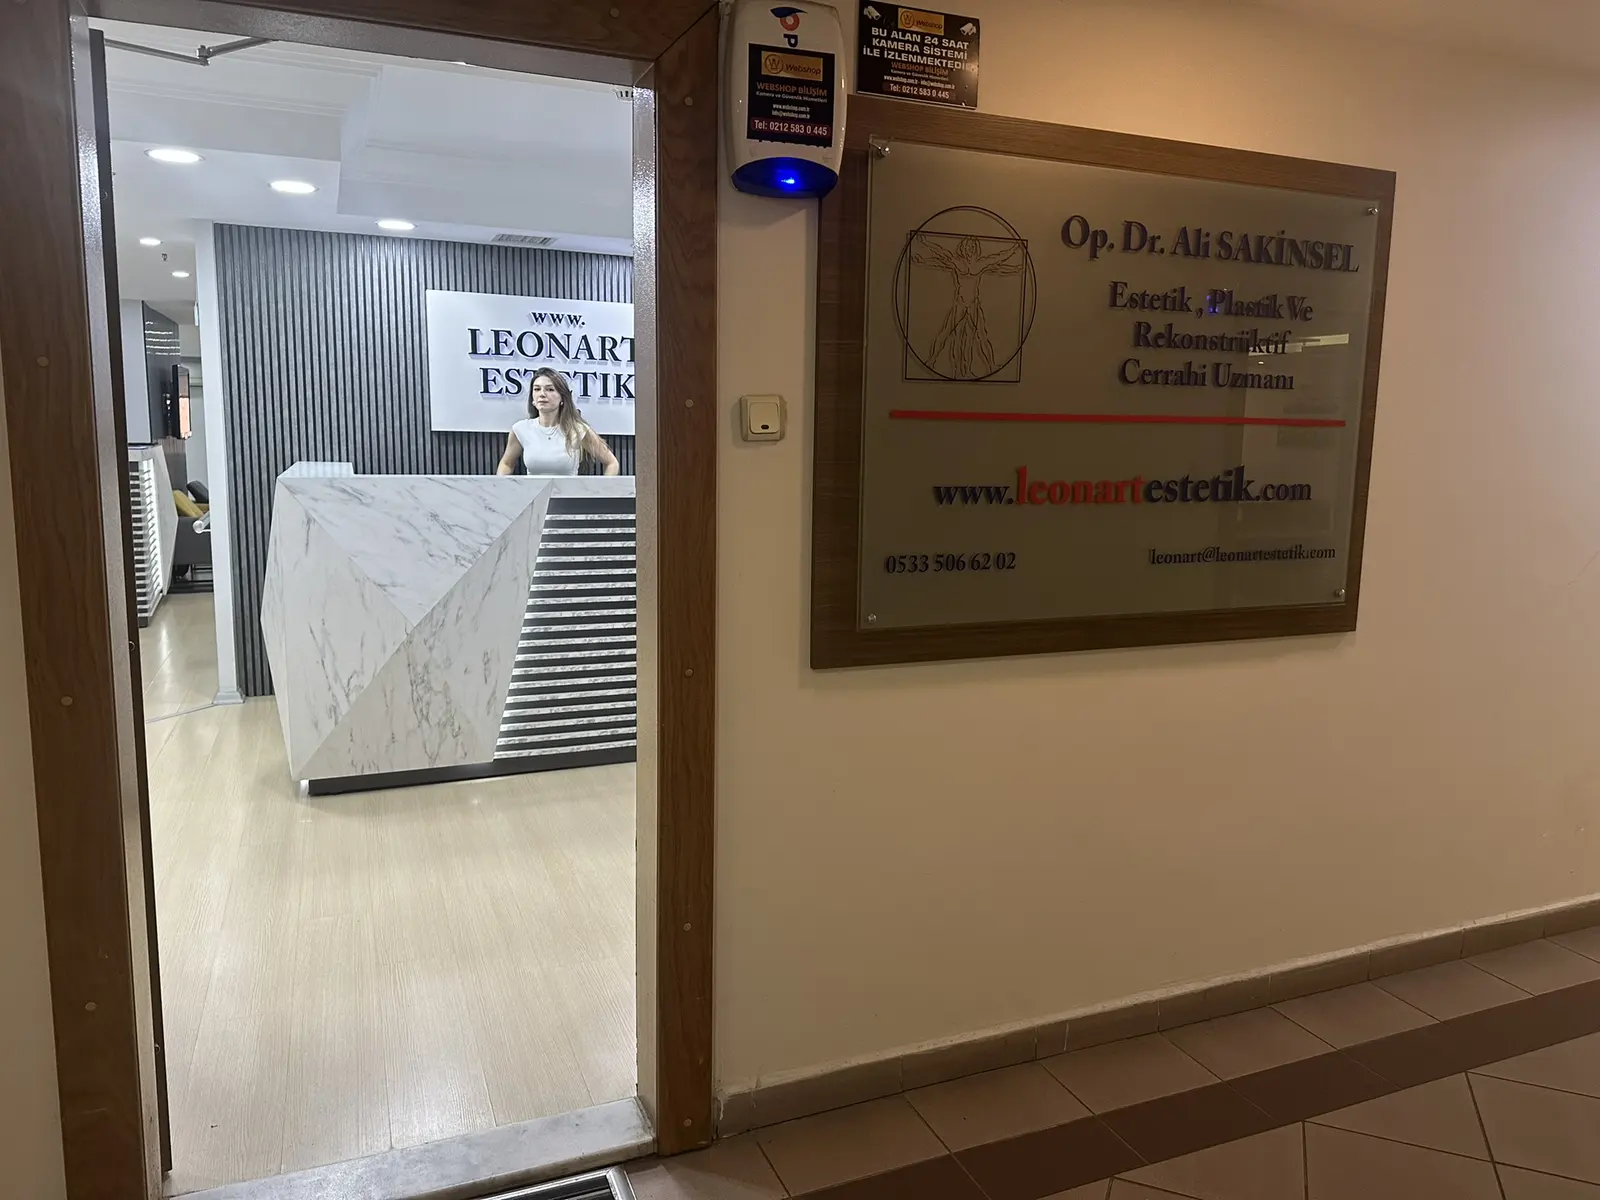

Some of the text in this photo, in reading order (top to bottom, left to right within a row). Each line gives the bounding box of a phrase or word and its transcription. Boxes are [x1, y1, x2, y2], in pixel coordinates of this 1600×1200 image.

[871, 27, 969, 50] BU ALAN 24 SAAT
[872, 38, 968, 60] KAMERA SİSTEMİ
[785, 63, 822, 75] Webshop
[863, 45, 972, 71] İLE İZLENMEKTEDİ
[891, 62, 924, 72] WEBSHOP
[756, 81, 828, 97] WEBSHOP BİLİŞİM
[889, 83, 950, 99] Tel: 0212 583 0 445
[754, 120, 828, 136] Tel: 0212 583 0 445
[1061, 214, 1360, 272] Op. Dr. Ali SAKİNSEL
[1108, 280, 1193, 313] Estetik
[1207, 288, 1285, 319] Plastik
[1286, 295, 1314, 322] Ve
[529, 311, 586, 326] www.
[467, 328, 635, 363] LEONART
[1133, 320, 1292, 354] Rekonstrüktif
[479, 367, 635, 399] ESTIK
[1118, 357, 1295, 390] Cerrahi Uzmanı
[932, 465, 1312, 507] www.leonartestetik.com
[884, 551, 1017, 574] 0533 506 62 02
[1148, 544, 1337, 565] leonart@leonartestetik.com
